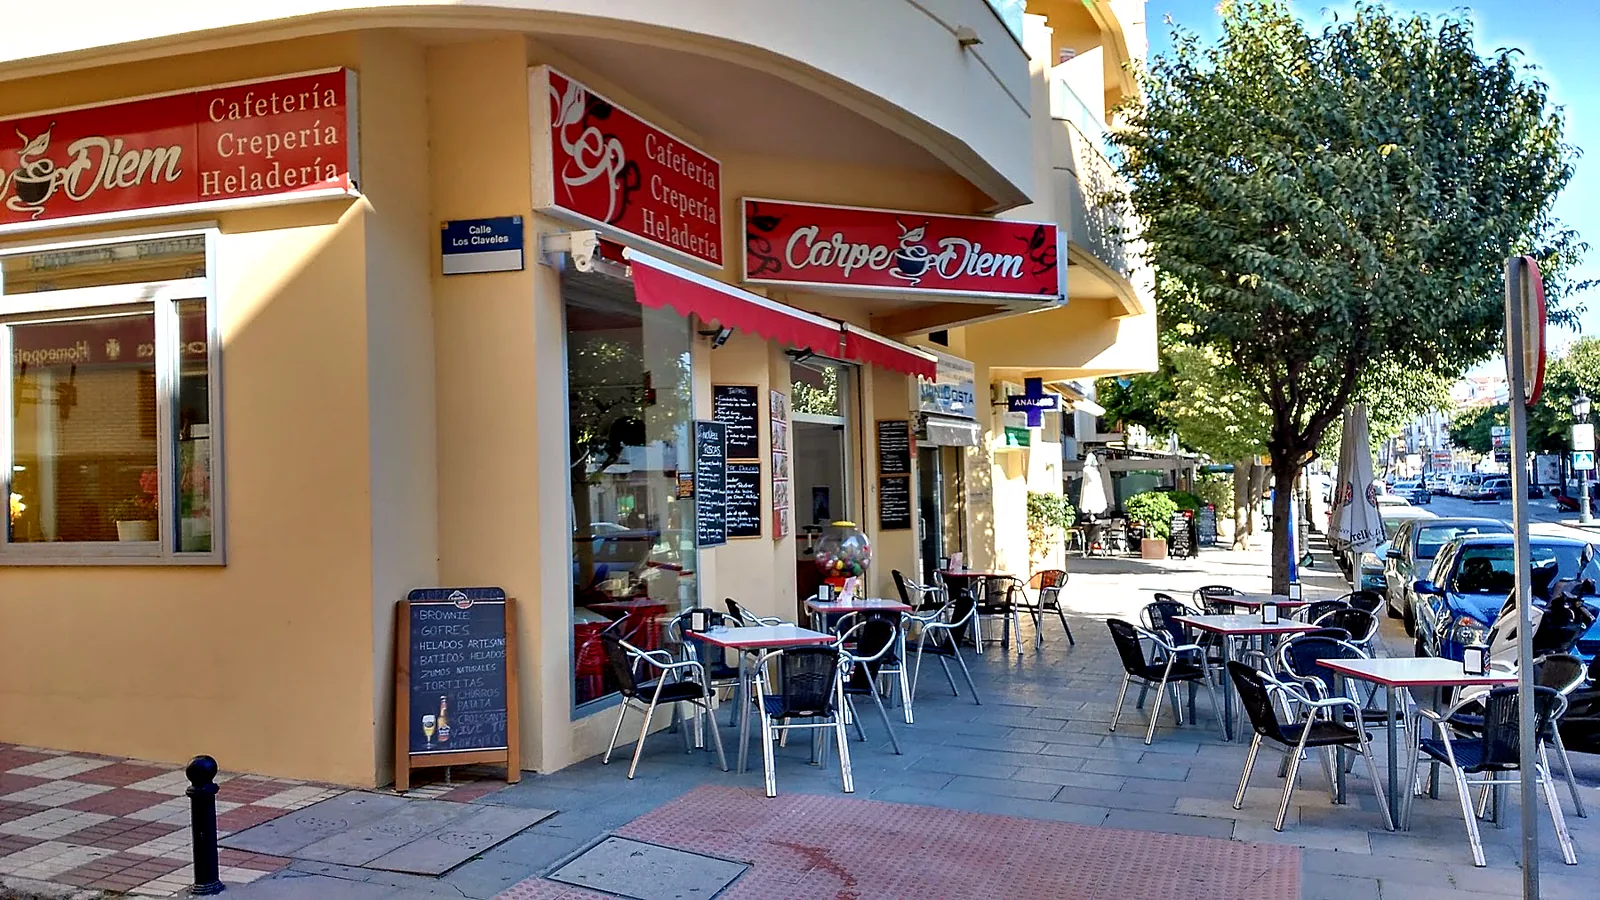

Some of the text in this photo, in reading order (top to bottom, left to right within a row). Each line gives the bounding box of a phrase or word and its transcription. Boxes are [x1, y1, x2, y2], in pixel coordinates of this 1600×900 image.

[209, 83, 337, 123] Cafetería
[217, 121, 338, 159] Crepería
[65, 136, 183, 202] Diem
[645, 133, 716, 190] Cafetería
[201, 161, 339, 196] Heladería
[651, 174, 716, 224] Crepería
[453, 234, 509, 246] Los Claveles
[469, 225, 492, 235] Calle
[642, 207, 717, 260] Heladería
[785, 226, 1024, 279] Carpe Diem
[419, 609, 471, 621] BROWNIE
[421, 624, 470, 636] GOFRES
[419, 639, 464, 651] HELADOS
[420, 649, 506, 666] BATIDOS HELADOS
[420, 663, 496, 679] ZUMOS NATURALES
[424, 677, 484, 691] TORTITAS
